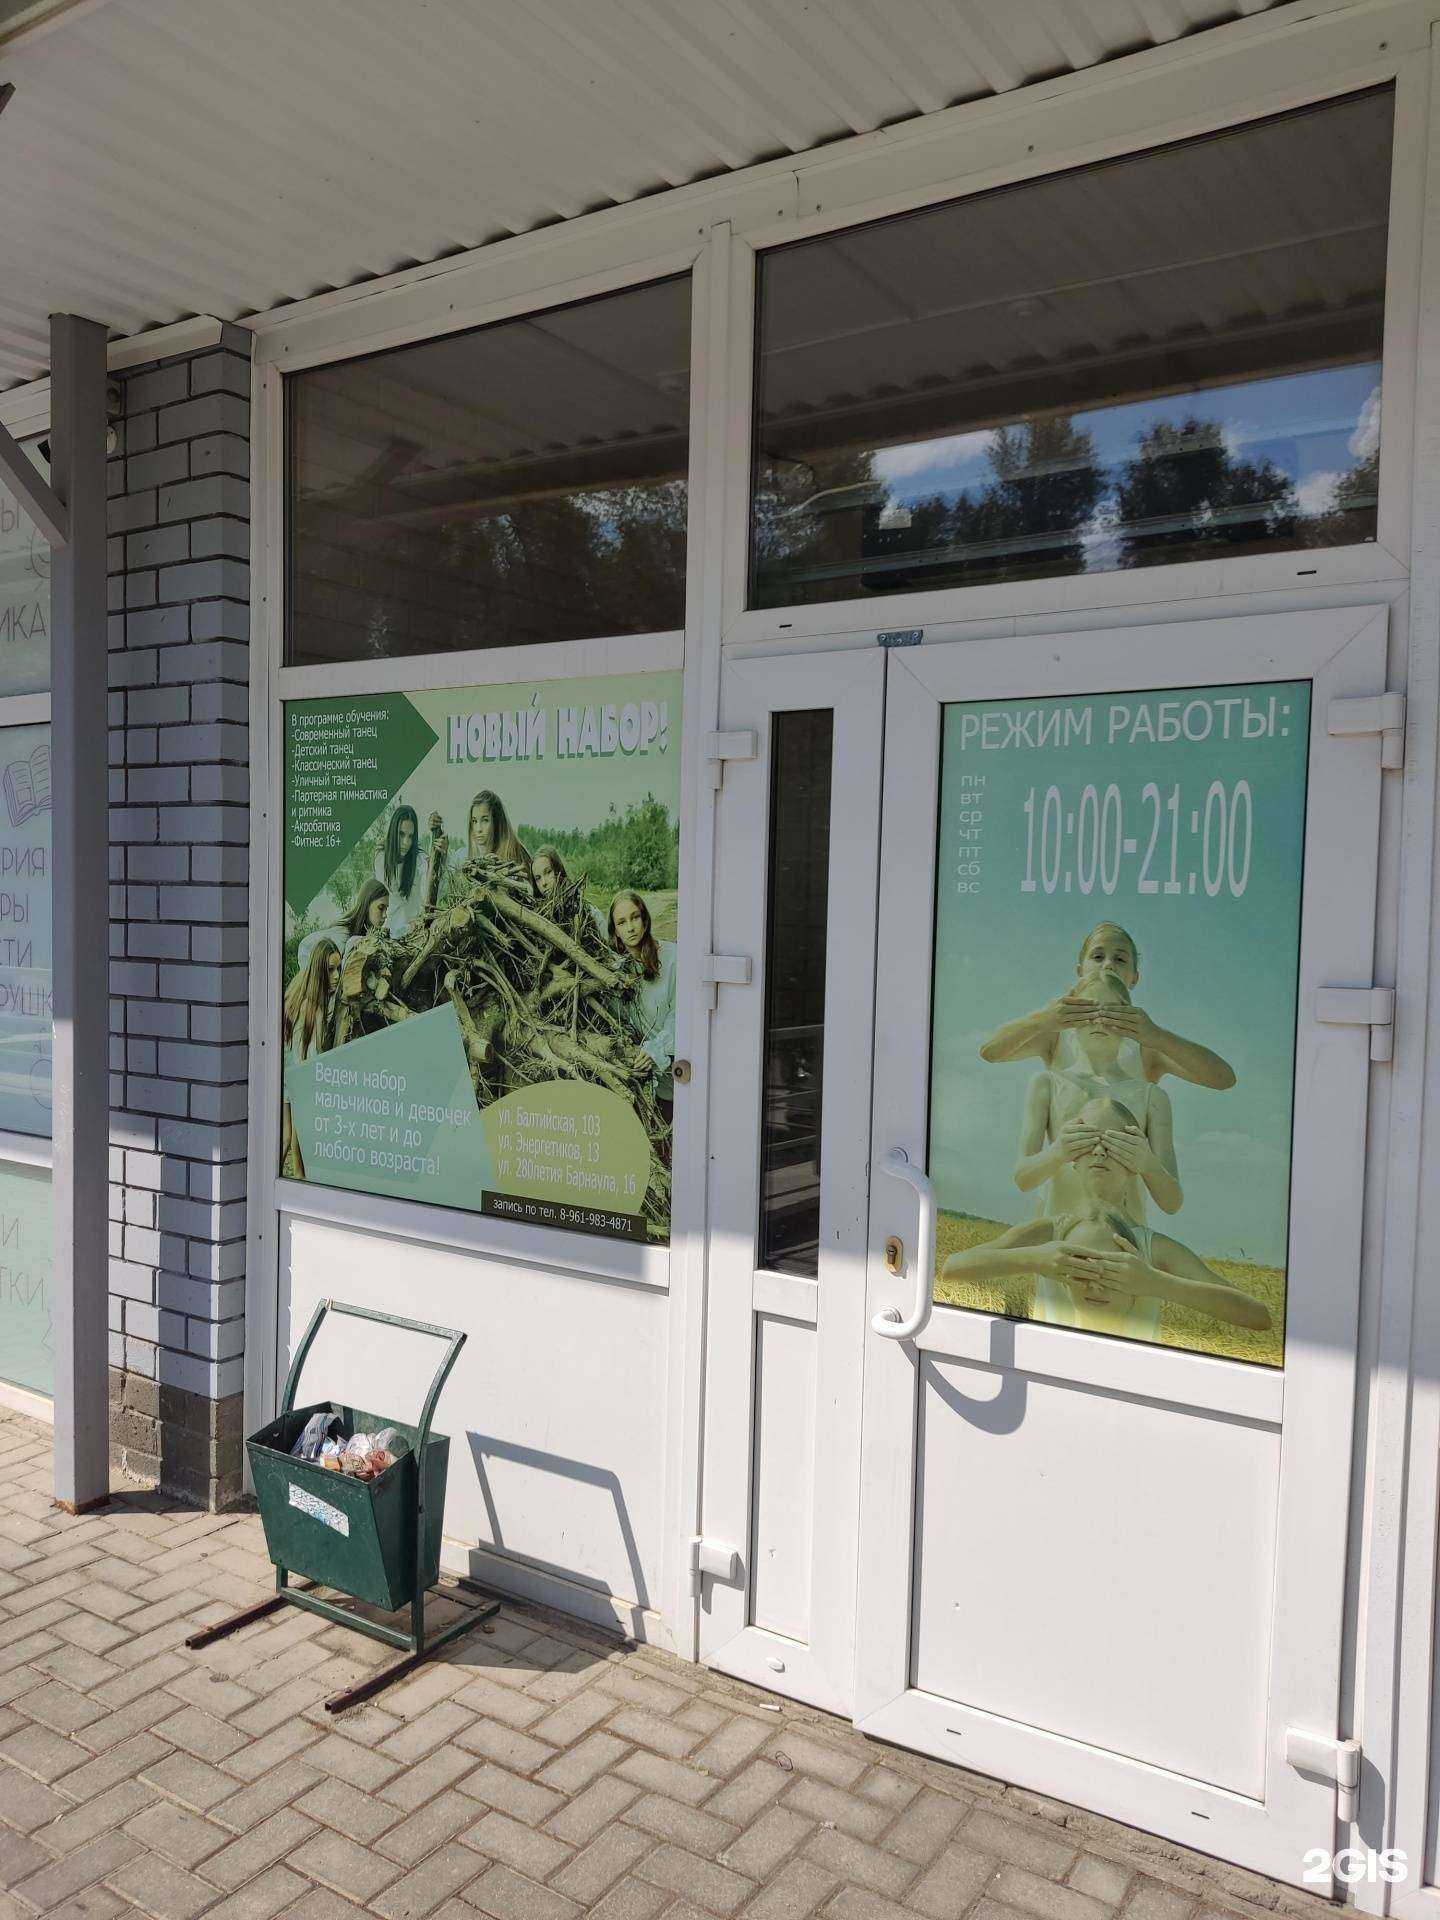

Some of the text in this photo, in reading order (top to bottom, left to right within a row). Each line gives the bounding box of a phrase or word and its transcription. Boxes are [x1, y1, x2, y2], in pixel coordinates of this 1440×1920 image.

[292, 709, 390, 728] В программе обучения:
[447, 689, 668, 764] НОВЫЙ НАБОР!
[960, 696, 1291, 750] РЕЖИМ РАБОТЫ:
[292, 724, 378, 743] -Современный танец
[292, 740, 354, 758] -Детский танец
[292, 755, 378, 771] -Классический танец
[292, 771, 357, 787] -Уличный танец
[292, 789, 388, 804] -Партерная гимнастика
[292, 806, 332, 819] и ритмика
[292, 819, 341, 835] -Акробатика
[959, 811, 982, 825] ср
[292, 835, 341, 847] -Фитнес 16+
[1020, 779, 1252, 898] 10:00-21:00
[2, 847, 45, 876] РИЯ
[958, 861, 980, 876] сб
[0, 892, 29, 922] РЫ
[0, 939, 32, 968] ТИ
[315, 1062, 406, 1096] Ведем набор
[314, 1091, 472, 1126] мальчиков и девочек
[499, 1104, 600, 1137] ул. Балтийская, 103
[314, 1115, 422, 1148] от 3-х лет и до
[314, 1140, 440, 1175] любого возраста!
[498, 1132, 600, 1164] ул. Энергетиков, 13
[498, 1158, 636, 1196] ул. 280летия Барнаула, 16
[493, 1199, 633, 1232] запись по тел. 8-961-983-4871
